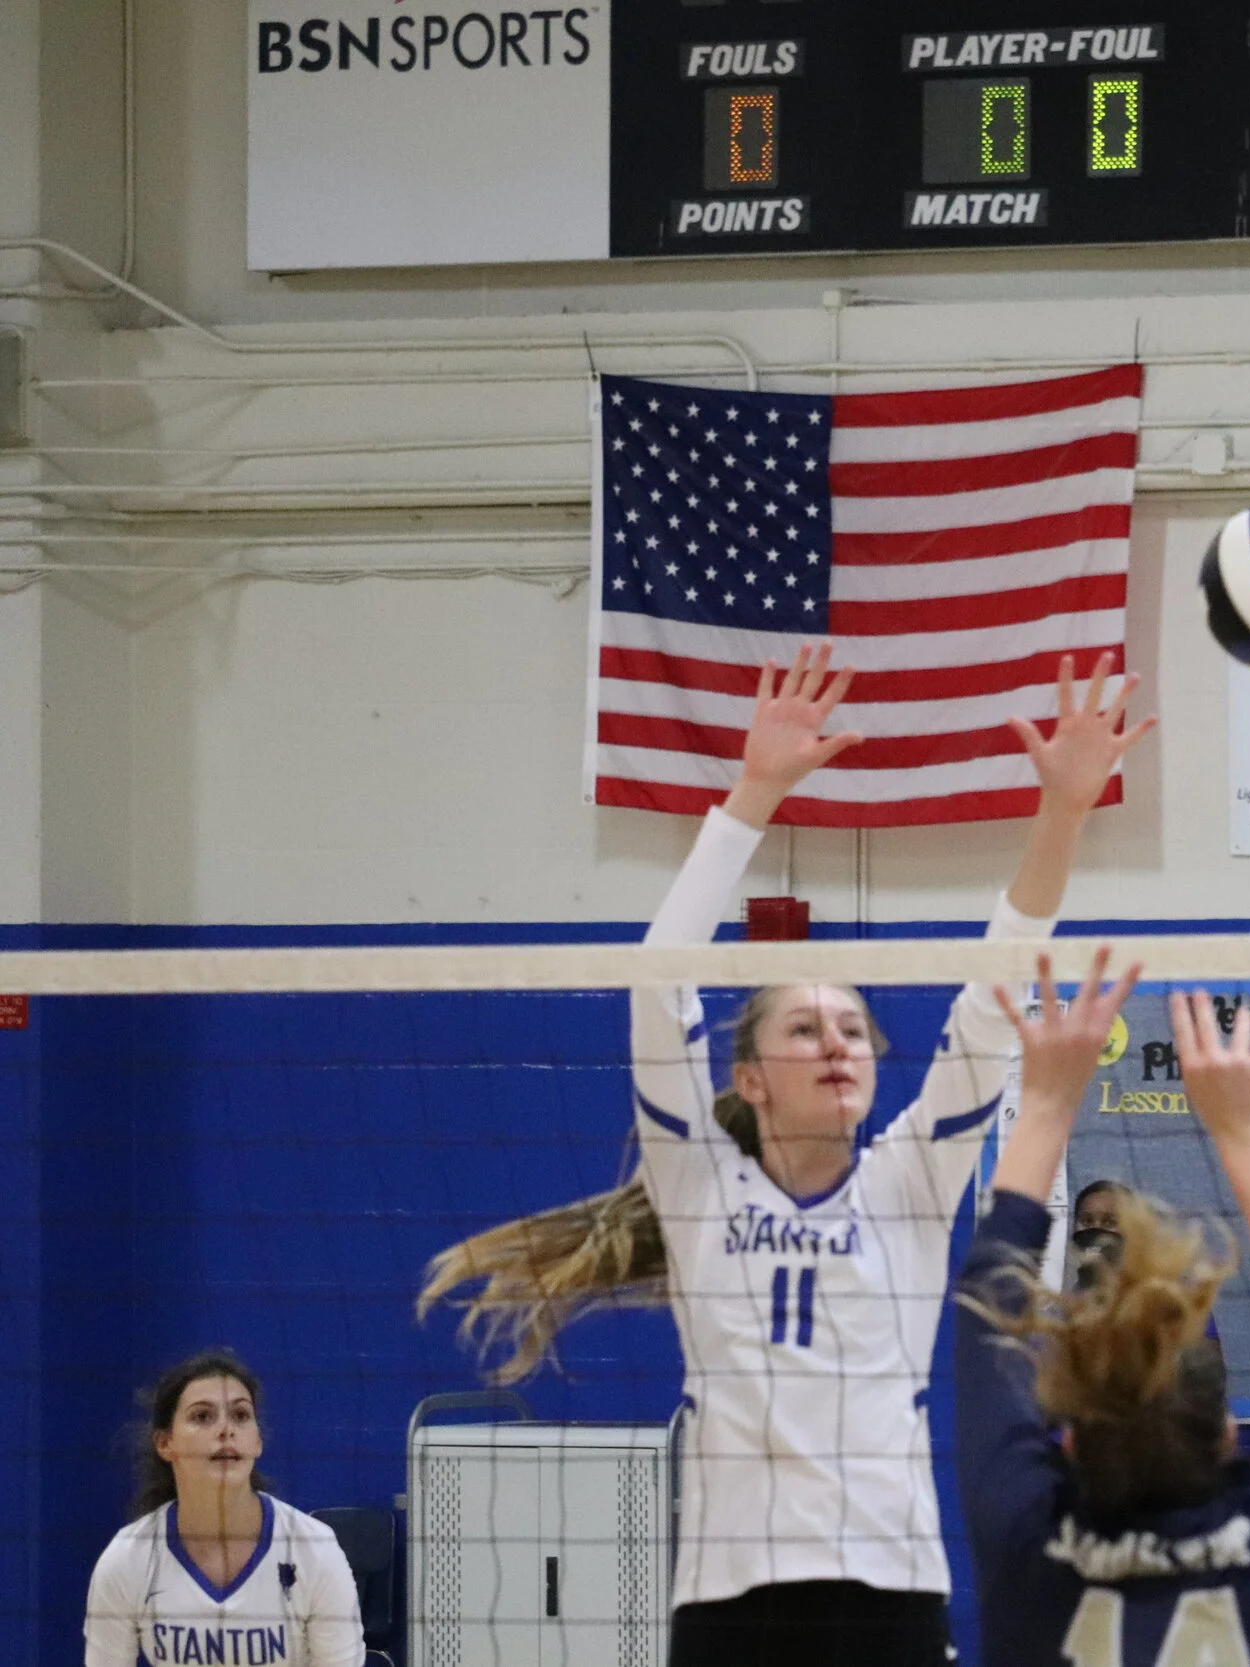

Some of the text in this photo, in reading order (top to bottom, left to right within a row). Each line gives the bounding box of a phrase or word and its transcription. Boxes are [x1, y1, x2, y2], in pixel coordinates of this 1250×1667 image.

[687, 43, 796, 77] FOULS
[909, 27, 1158, 68] PLAYER-FOUL
[729, 95, 773, 182] 0
[678, 199, 803, 233] POINTS
[911, 193, 1040, 226] MATCH
[771, 1266, 816, 1347] 11
[153, 1622, 287, 1667] STANTON
